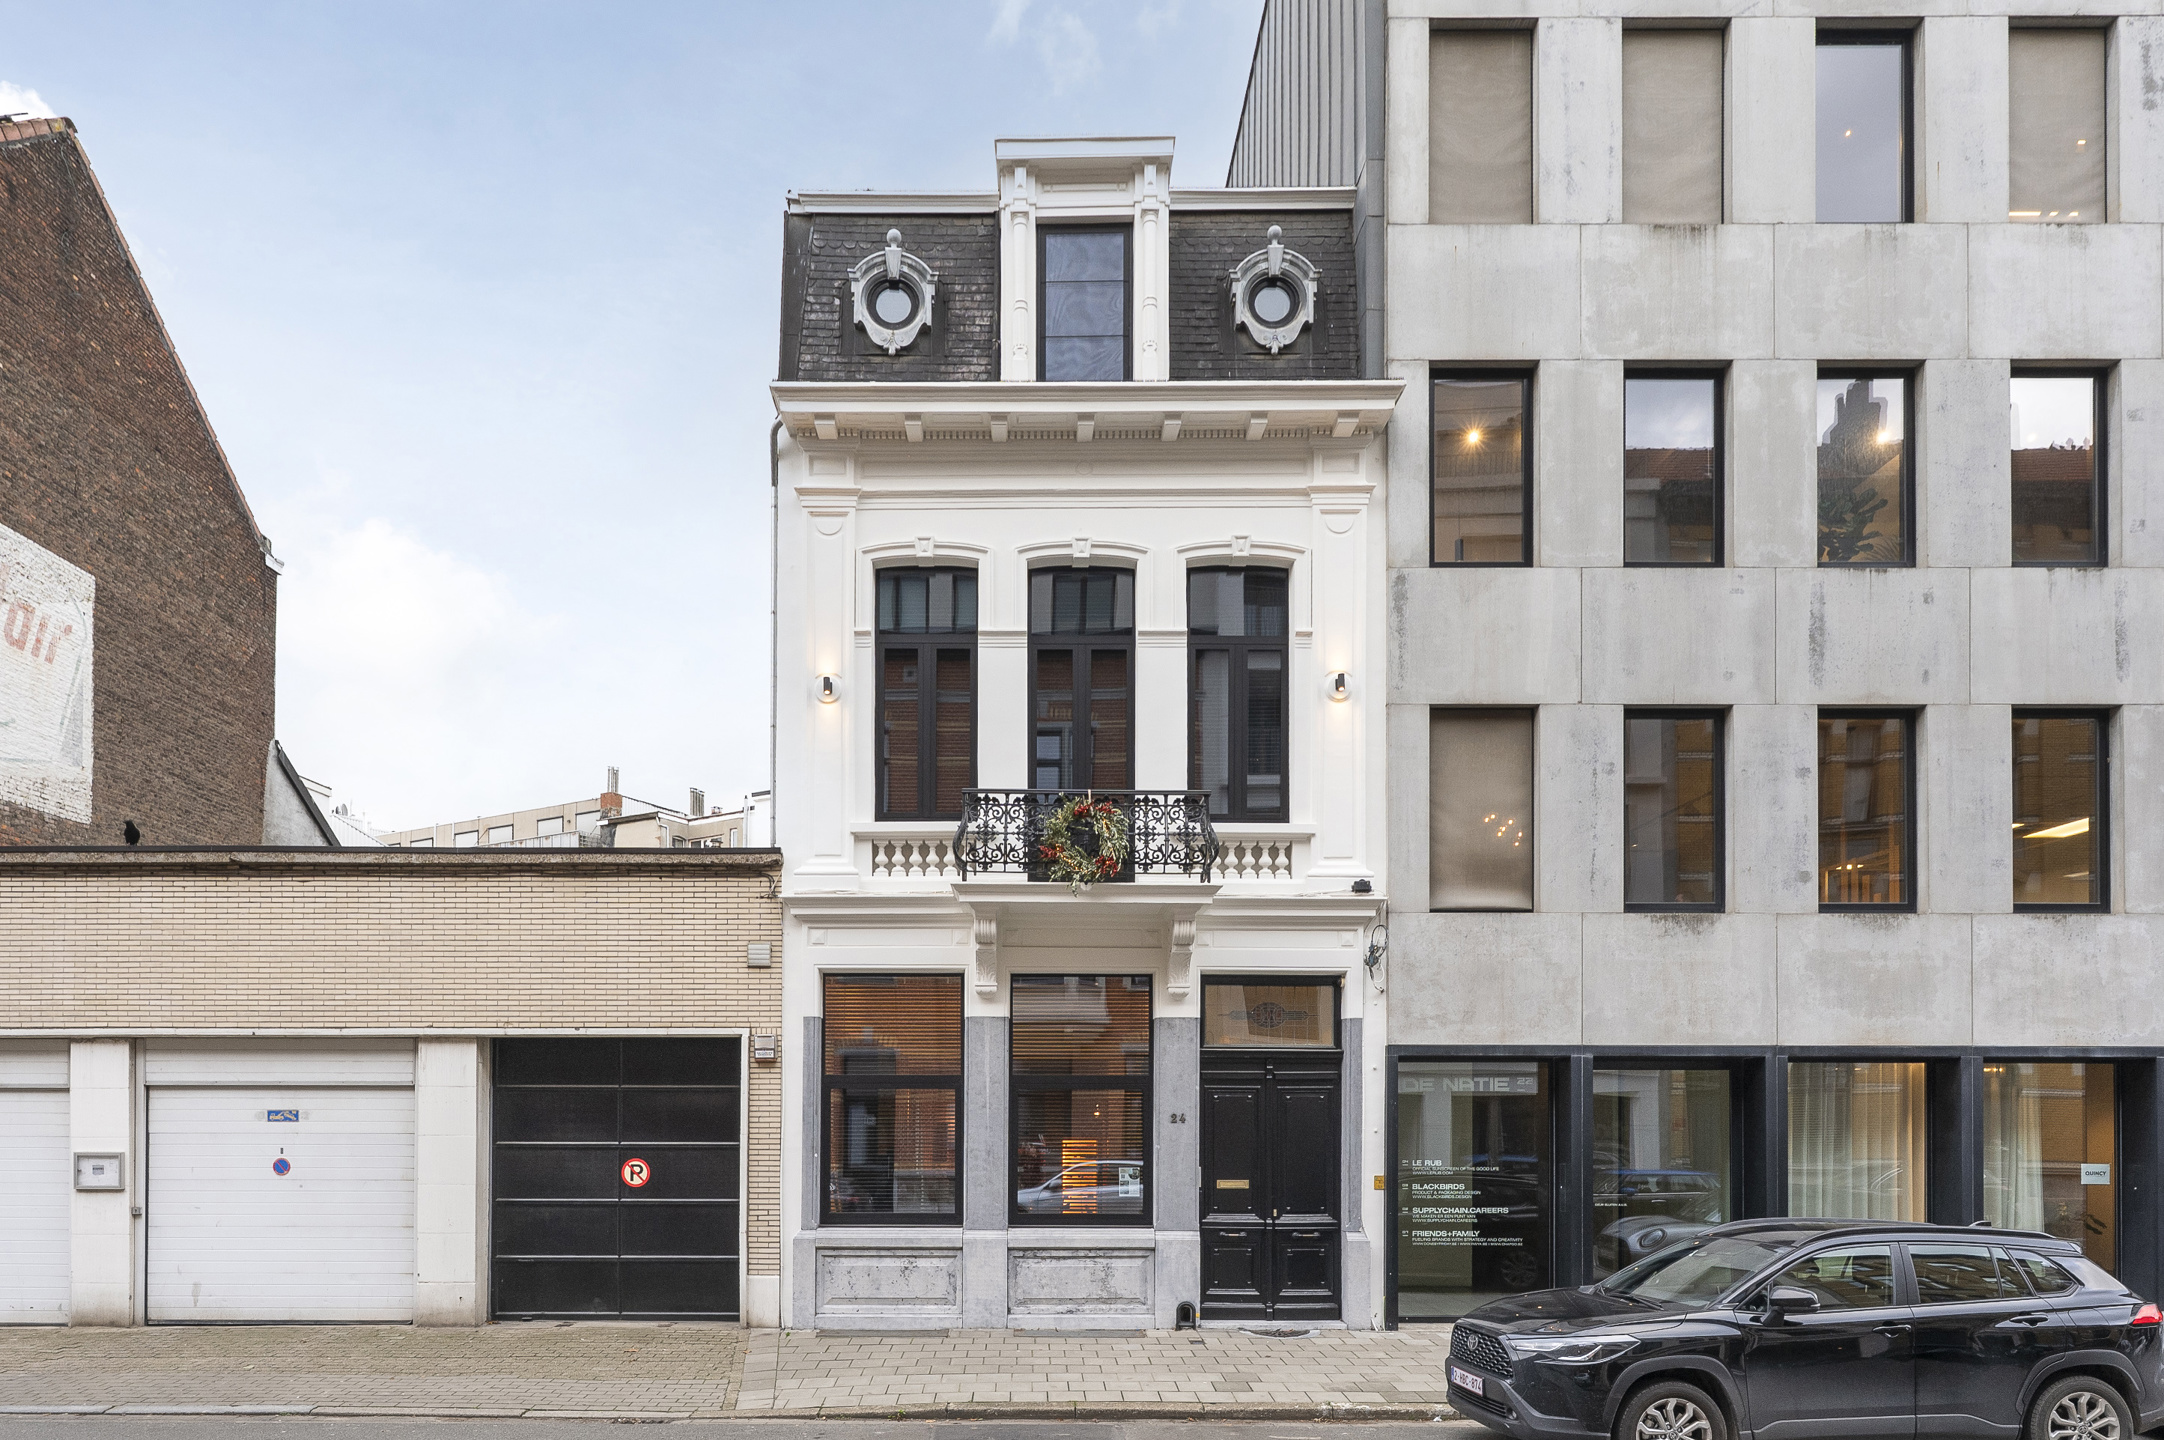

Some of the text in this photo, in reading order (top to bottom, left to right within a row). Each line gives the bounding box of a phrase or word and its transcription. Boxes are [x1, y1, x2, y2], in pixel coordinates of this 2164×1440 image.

[1402, 1077, 1510, 1092] DE NATIE
[1516, 1077, 1534, 1085] 22
[1170, 1113, 1186, 1124] 24
